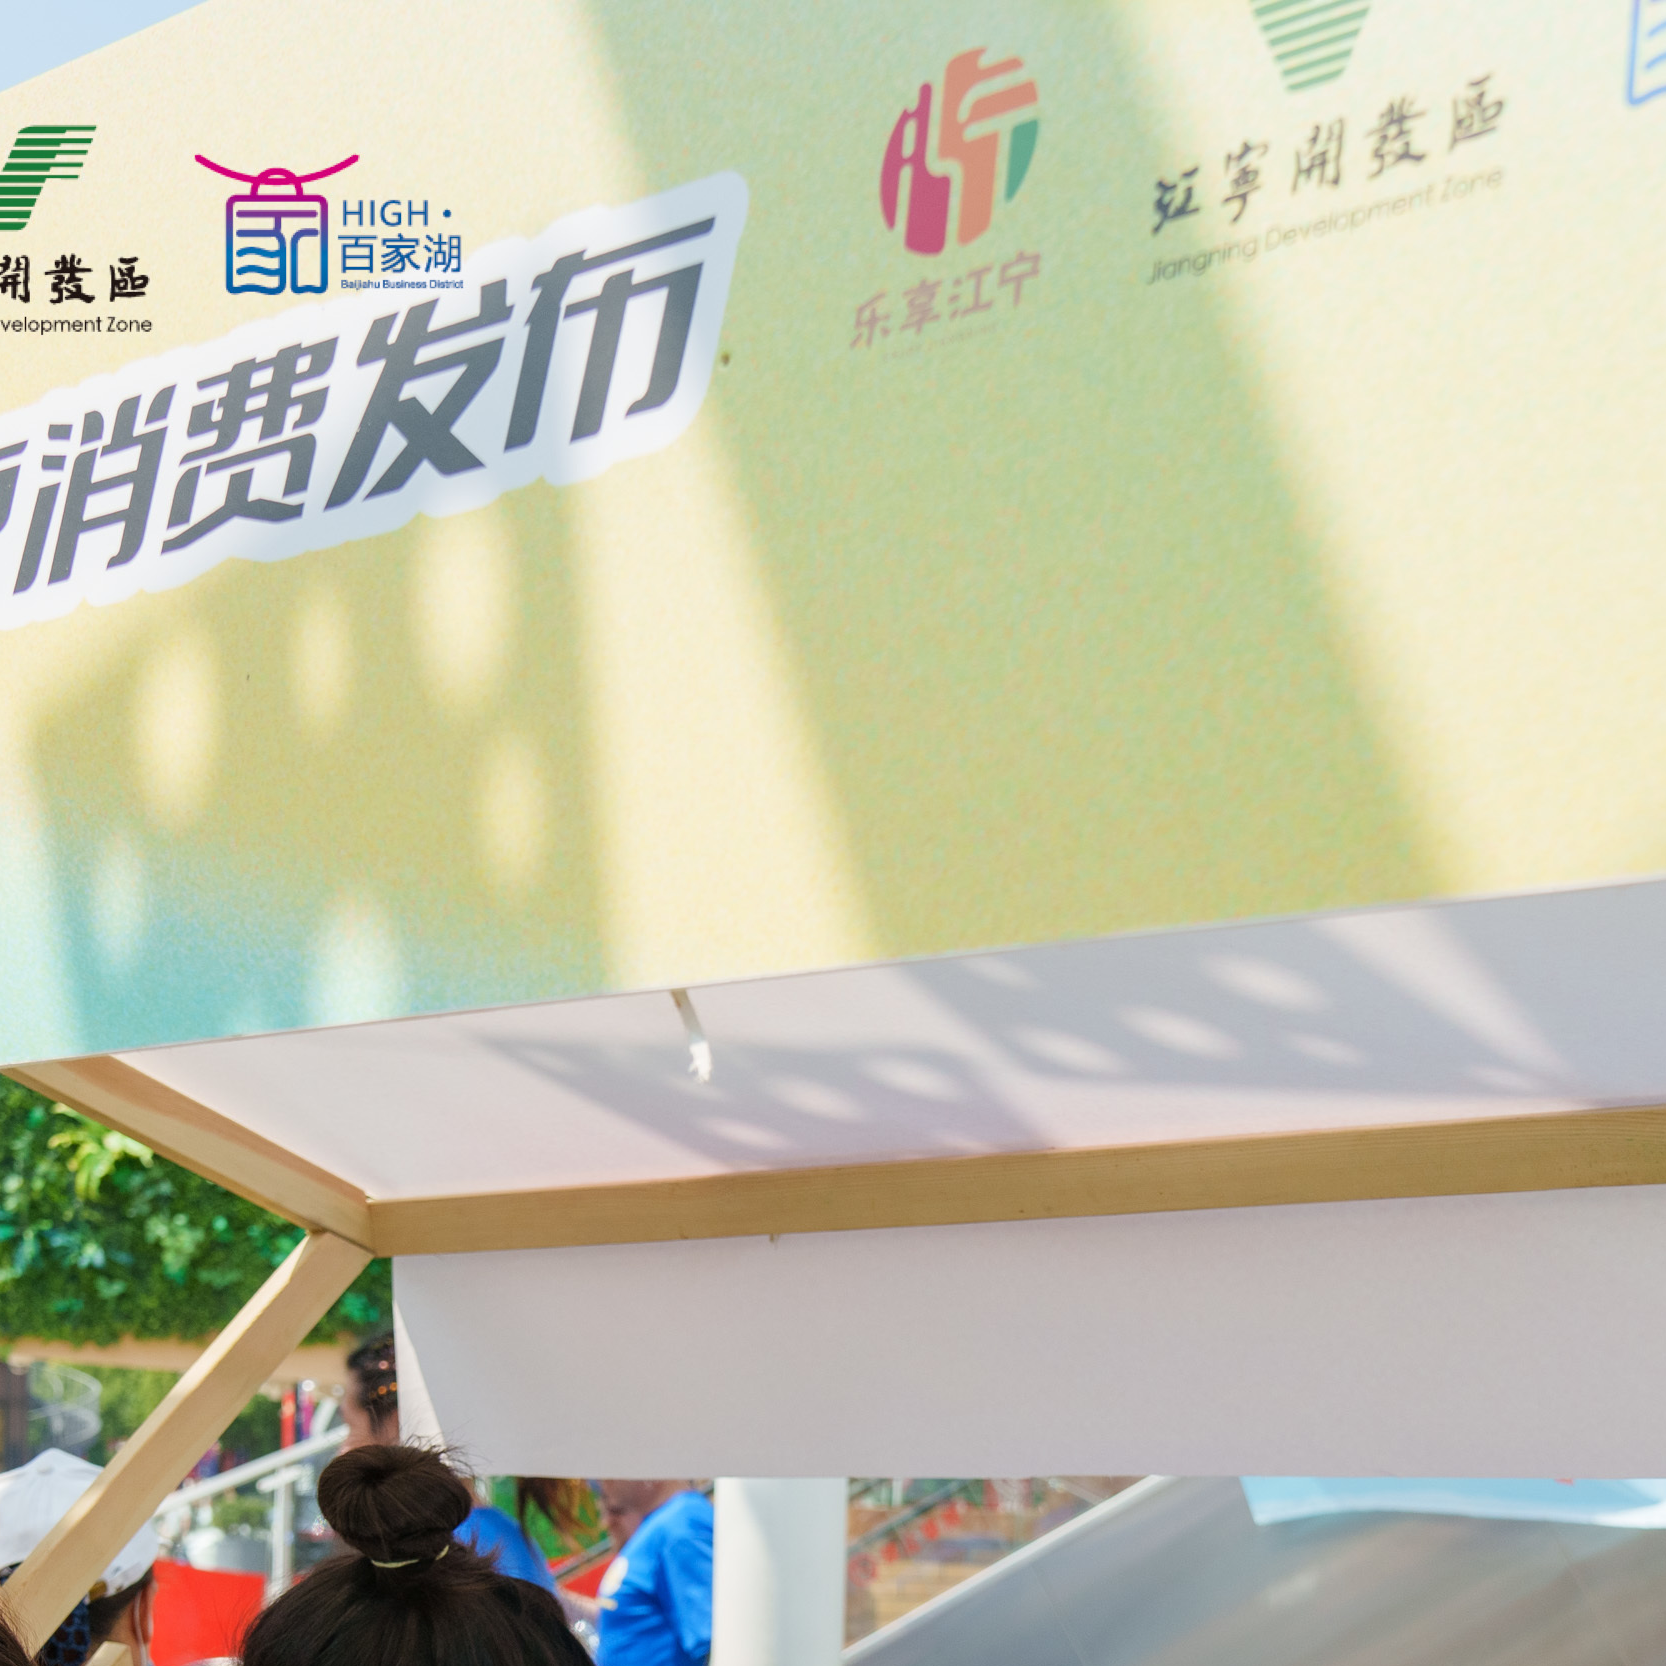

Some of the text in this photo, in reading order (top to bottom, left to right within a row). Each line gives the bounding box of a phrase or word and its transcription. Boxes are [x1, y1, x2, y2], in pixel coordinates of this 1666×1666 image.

[1148, 166, 1504, 285] Jiangning Development Zone
[850, 251, 1041, 349] 乐享江宁
